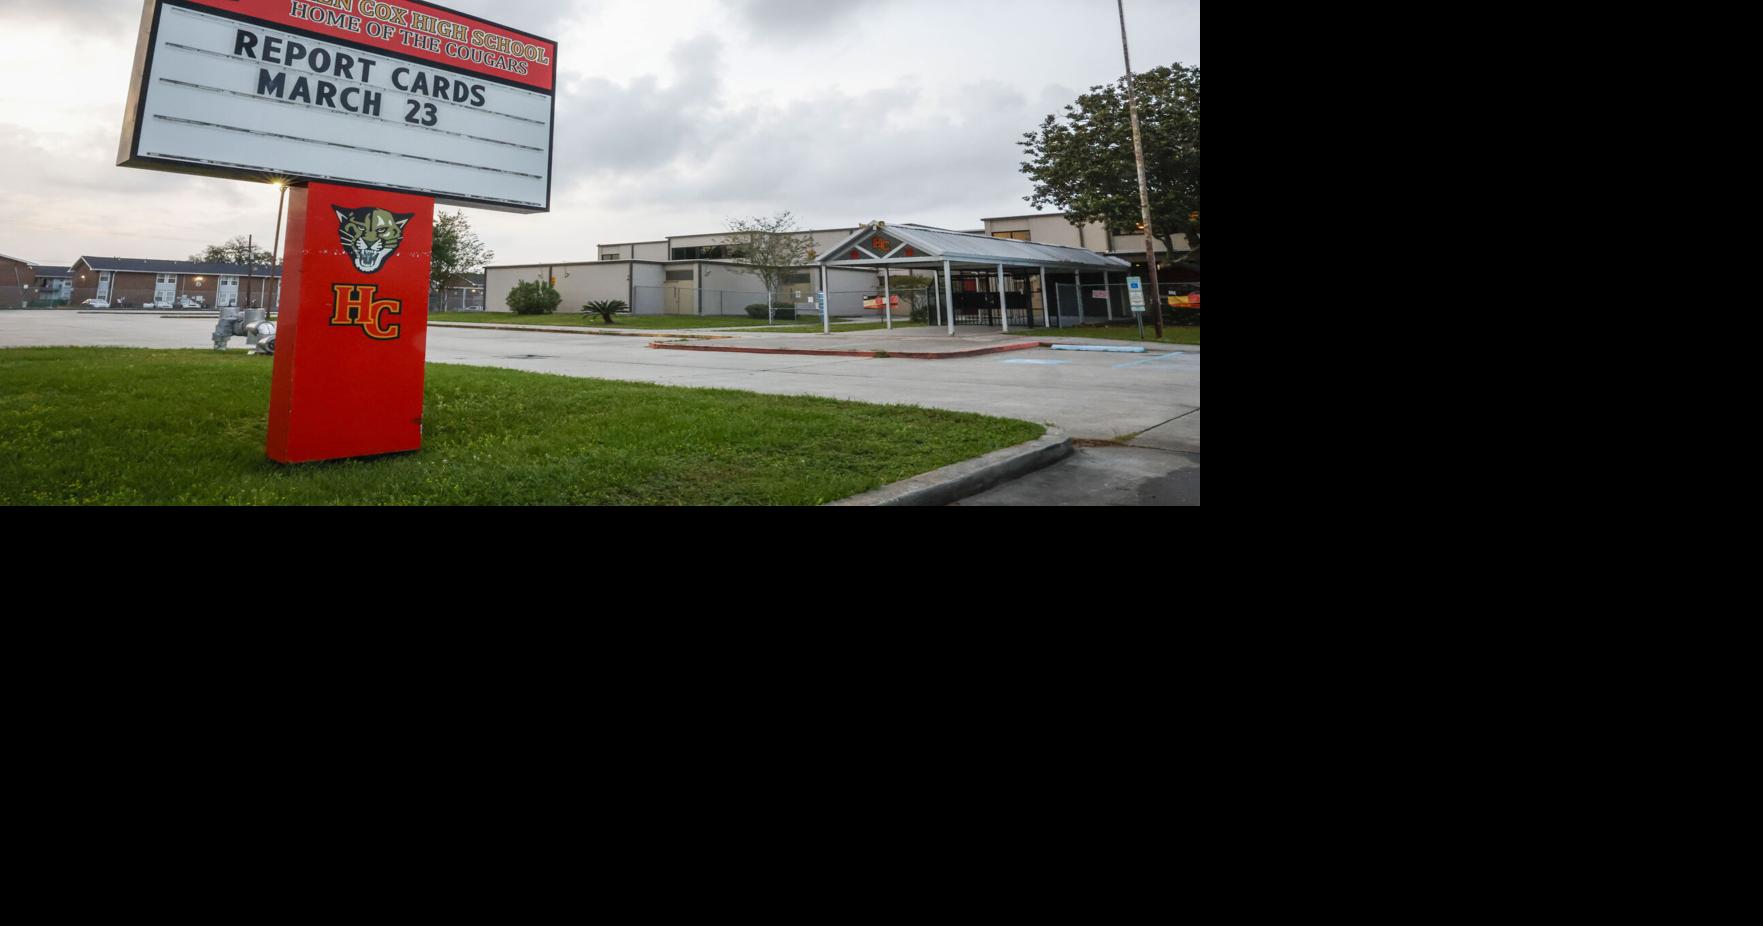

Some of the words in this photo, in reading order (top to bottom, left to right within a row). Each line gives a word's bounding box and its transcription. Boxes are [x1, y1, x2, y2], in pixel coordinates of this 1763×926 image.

[290, 1, 361, 33] HOME
[366, 21, 396, 41] OF
[399, 27, 440, 54] THE
[445, 42, 528, 75] COUGARS
[358, 0, 408, 26] COX
[410, 11, 468, 43] HIGH
[471, 30, 549, 65] SCHOOL
[234, 29, 376, 82] REPORT
[391, 67, 485, 106] CARDS
[257, 68, 381, 116] MARCH
[404, 99, 437, 126] 23
[329, 284, 401, 340] HC
